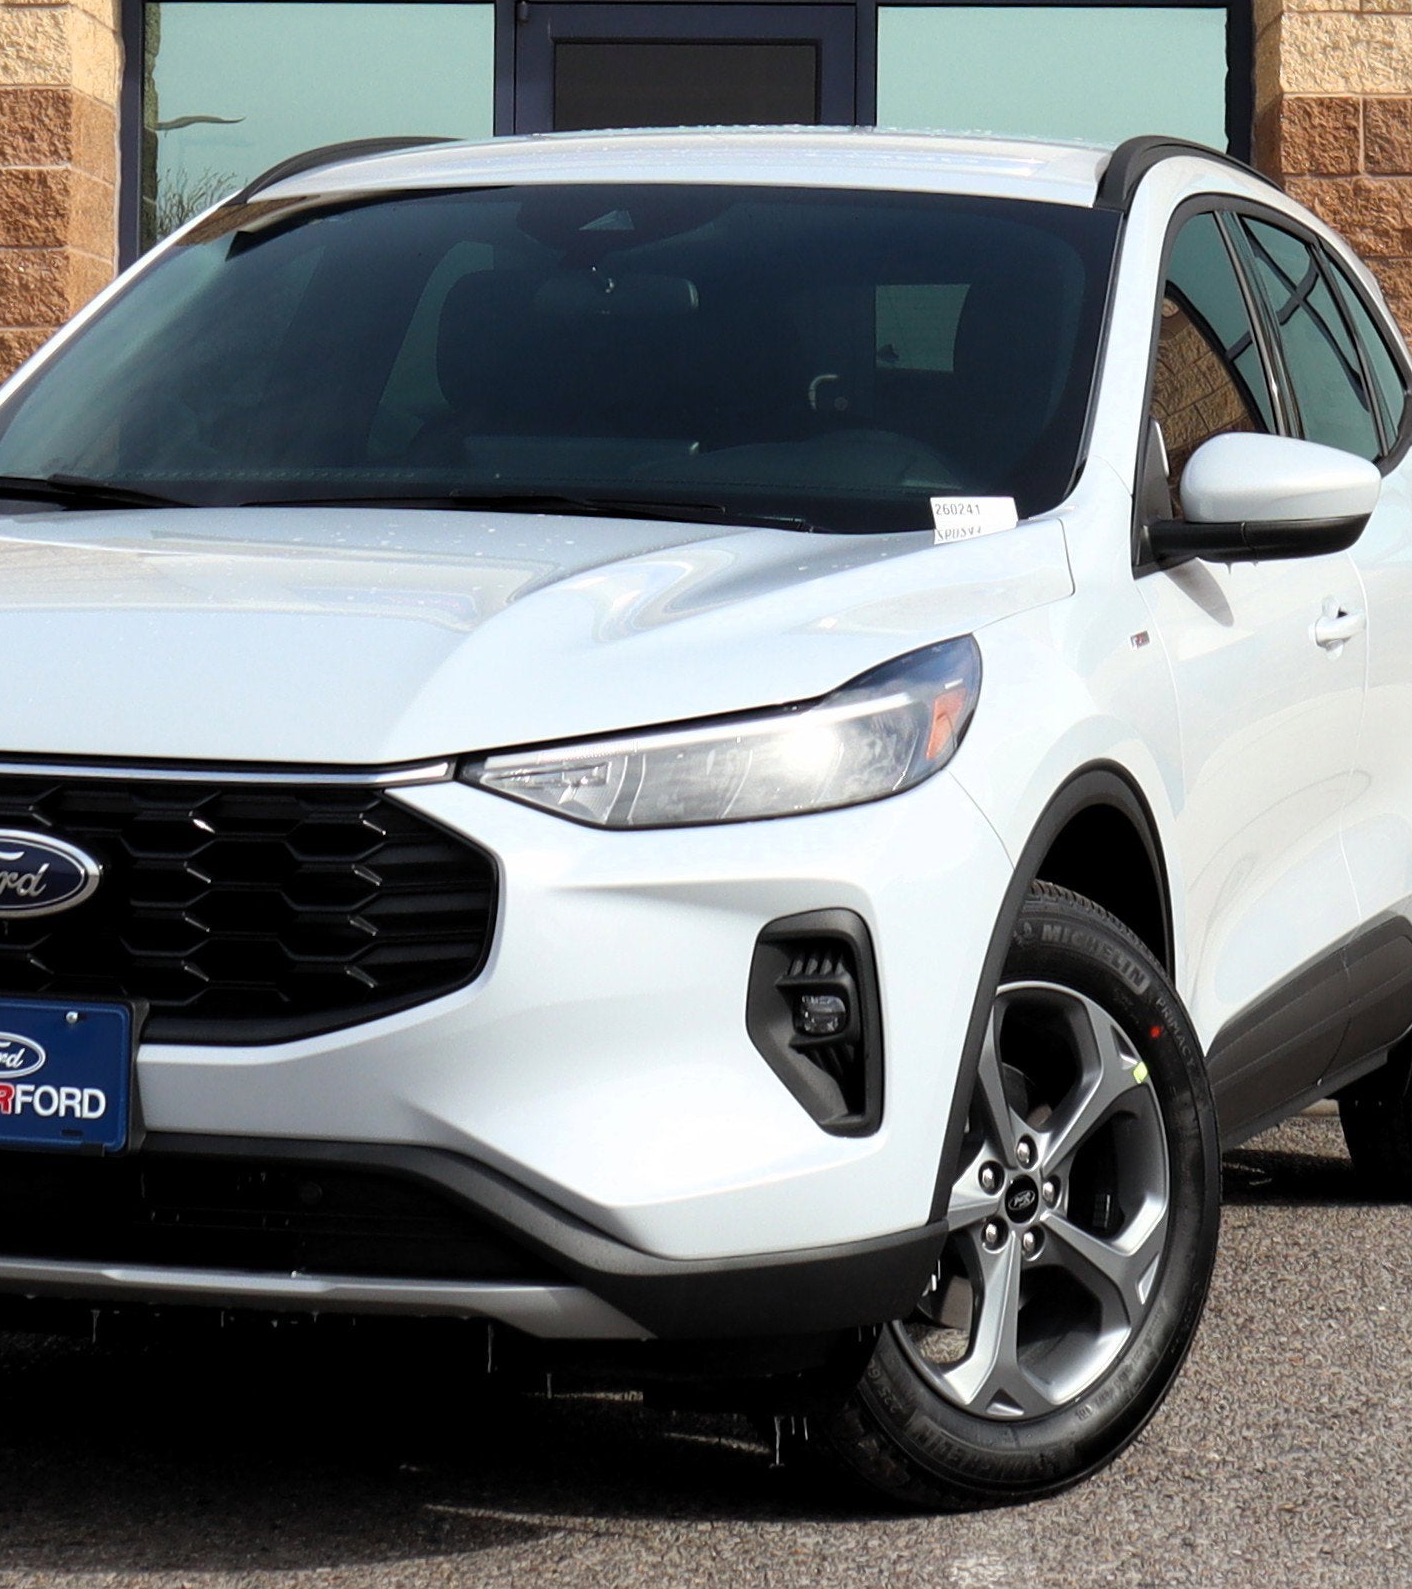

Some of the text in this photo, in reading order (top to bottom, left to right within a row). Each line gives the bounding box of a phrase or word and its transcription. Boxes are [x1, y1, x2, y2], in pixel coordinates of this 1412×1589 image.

[935, 503, 981, 515] 260241
[1041, 924, 1146, 989] MICHELIN
[1155, 998, 1195, 1067] PRIMACY
